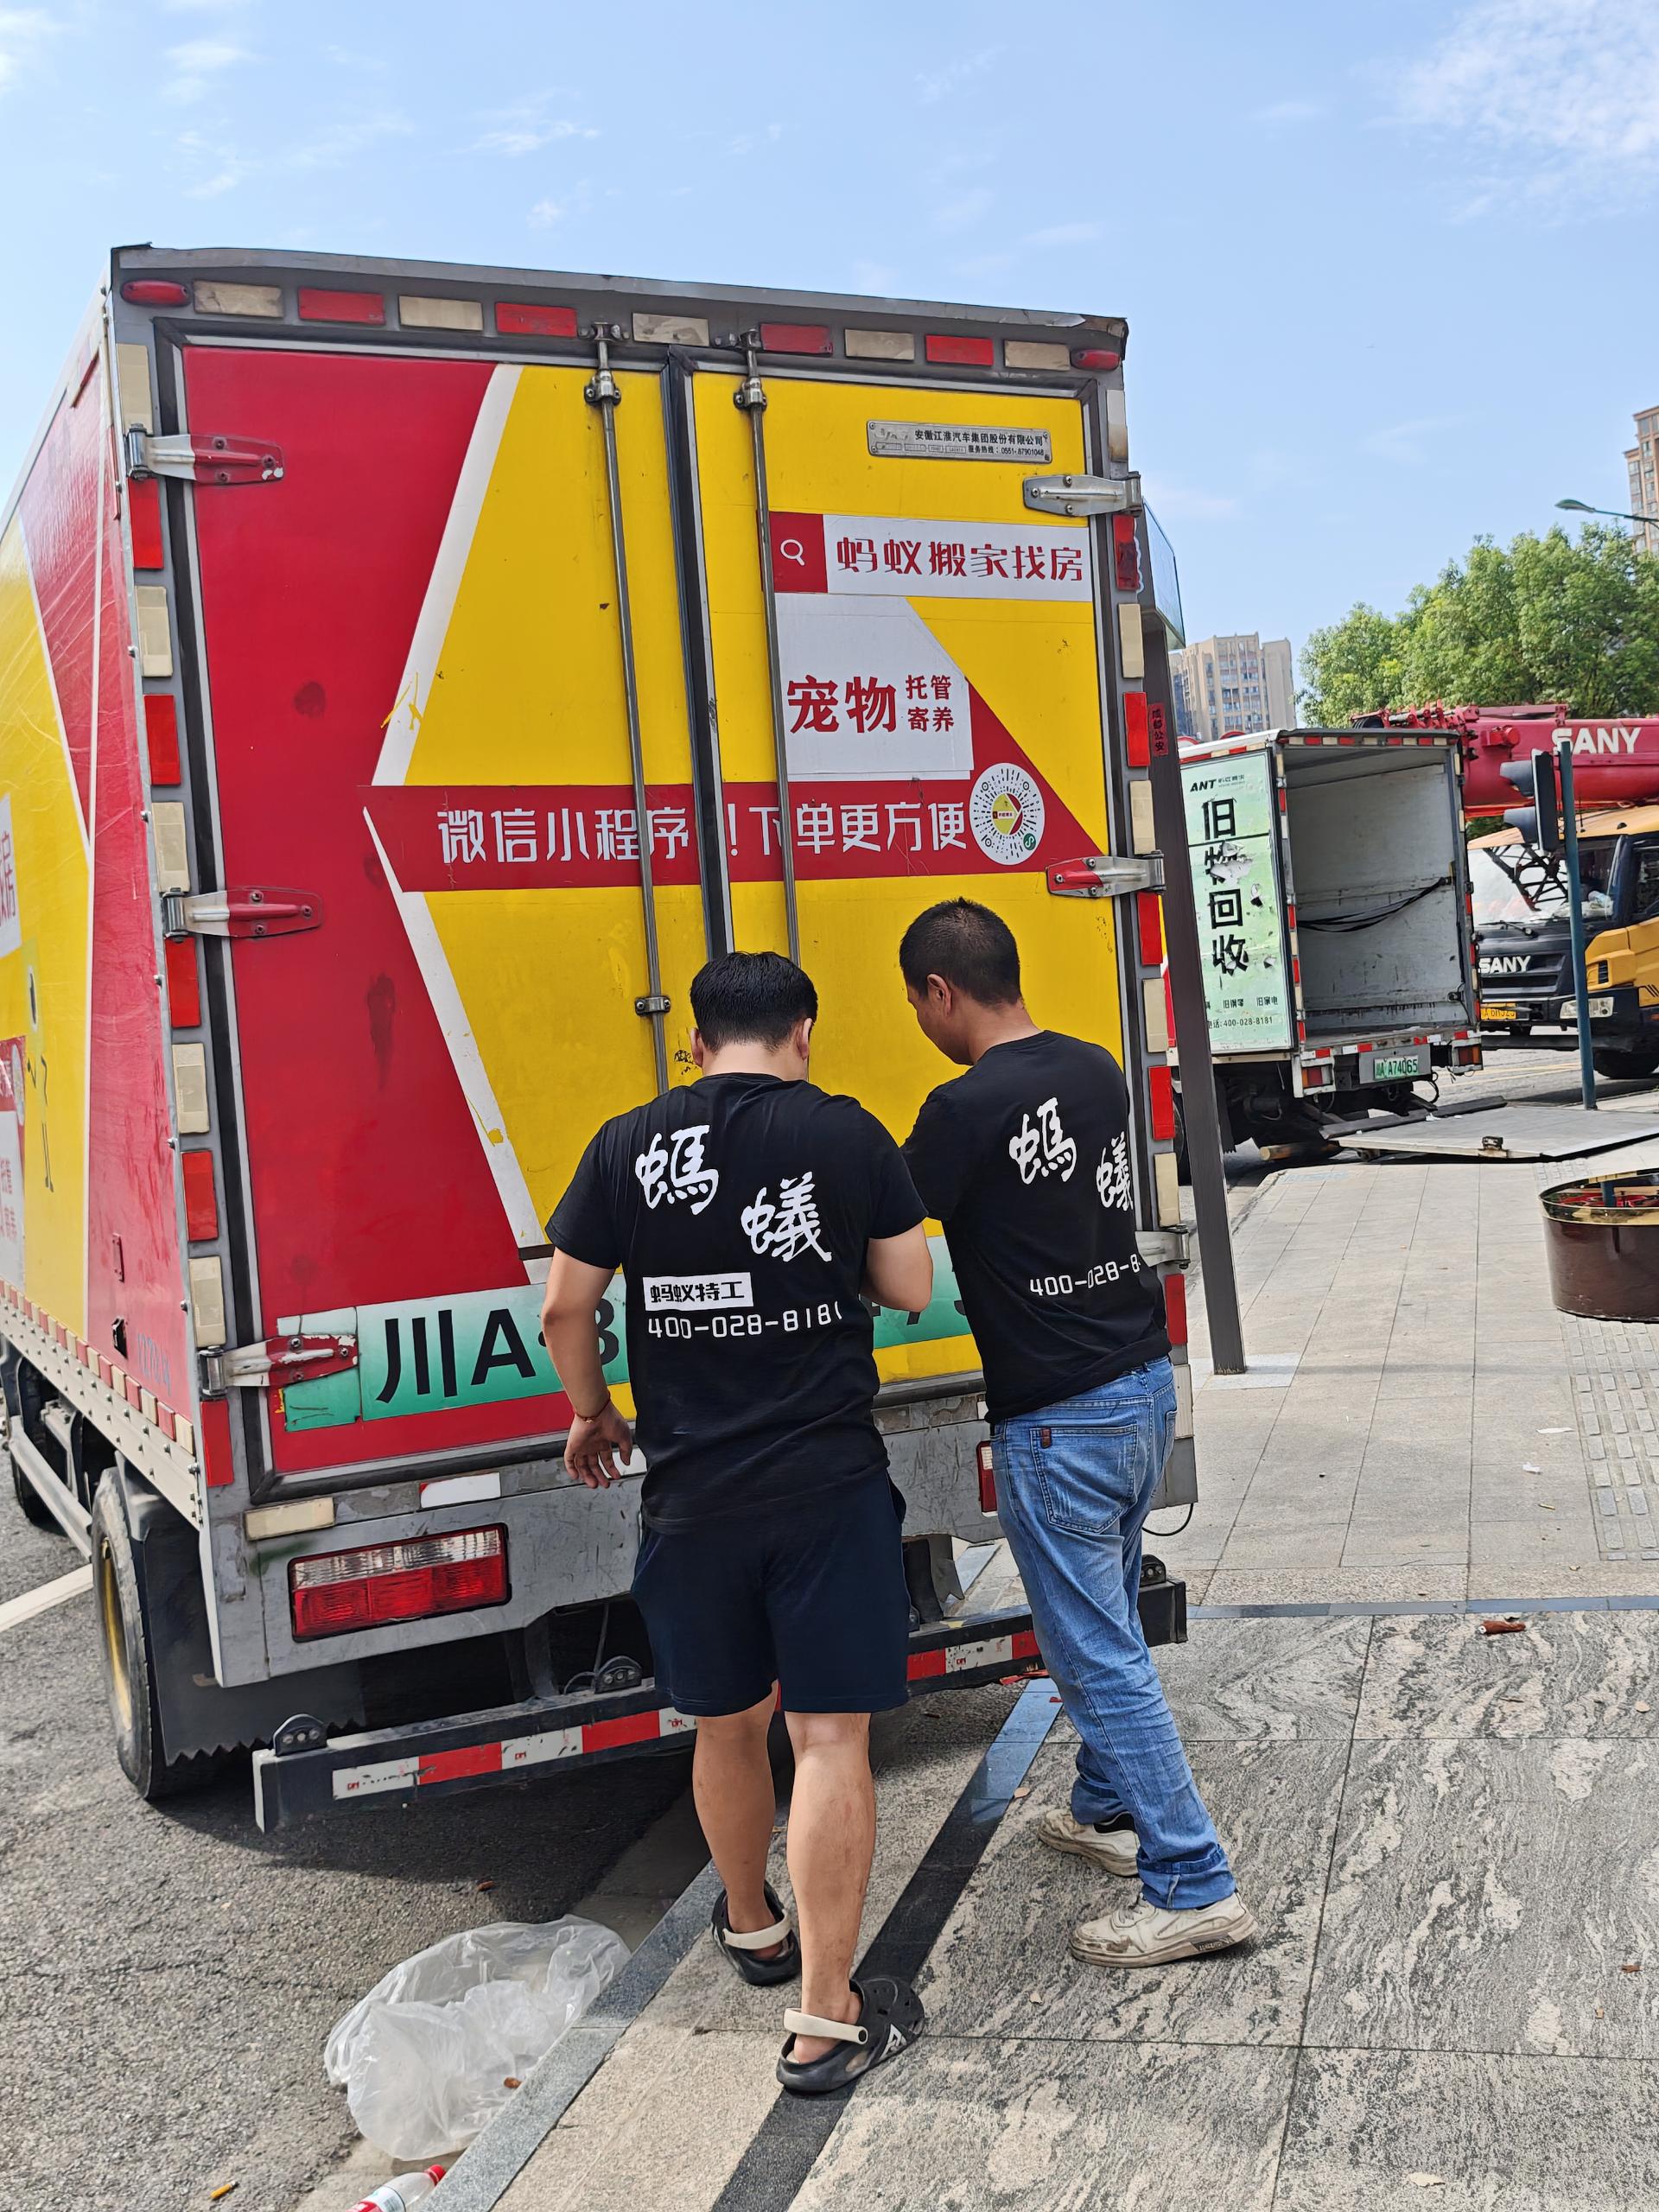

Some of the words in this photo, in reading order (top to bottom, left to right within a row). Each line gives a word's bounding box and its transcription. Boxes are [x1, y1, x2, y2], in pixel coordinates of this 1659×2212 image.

[914, 429, 1043, 446] 安徽江淮汽车集团股份有限公司
[836, 537, 1083, 582] 蚂蚁搬家找房
[905, 674, 951, 701] 托管
[786, 674, 897, 734] 宠物
[907, 705, 955, 734] 寄养
[1551, 727, 1642, 755] SANY
[1190, 779, 1217, 792] ANT
[1478, 955, 1531, 975] SANY
[650, 1281, 745, 1303] 蚂蚁特工
